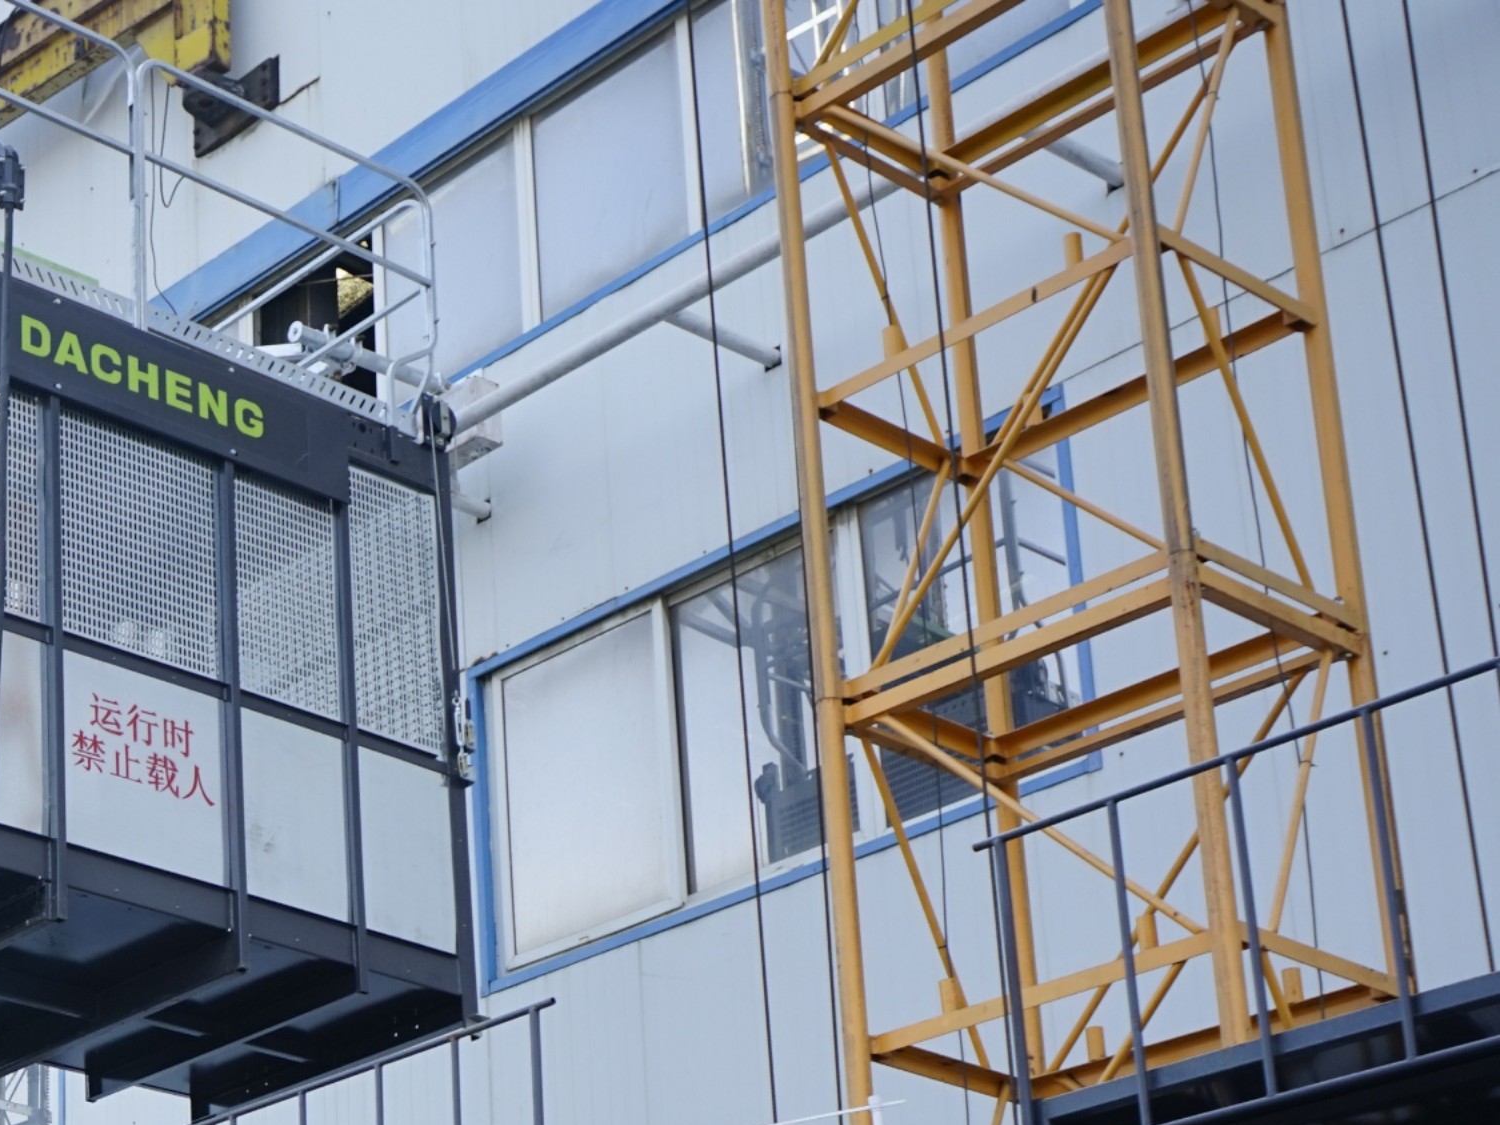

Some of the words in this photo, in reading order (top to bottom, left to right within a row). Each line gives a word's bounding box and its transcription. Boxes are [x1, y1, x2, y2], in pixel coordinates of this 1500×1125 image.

[19, 314, 265, 439] DACHENG
[88, 691, 195, 757] 运行时
[71, 731, 216, 808] 禁止载人
